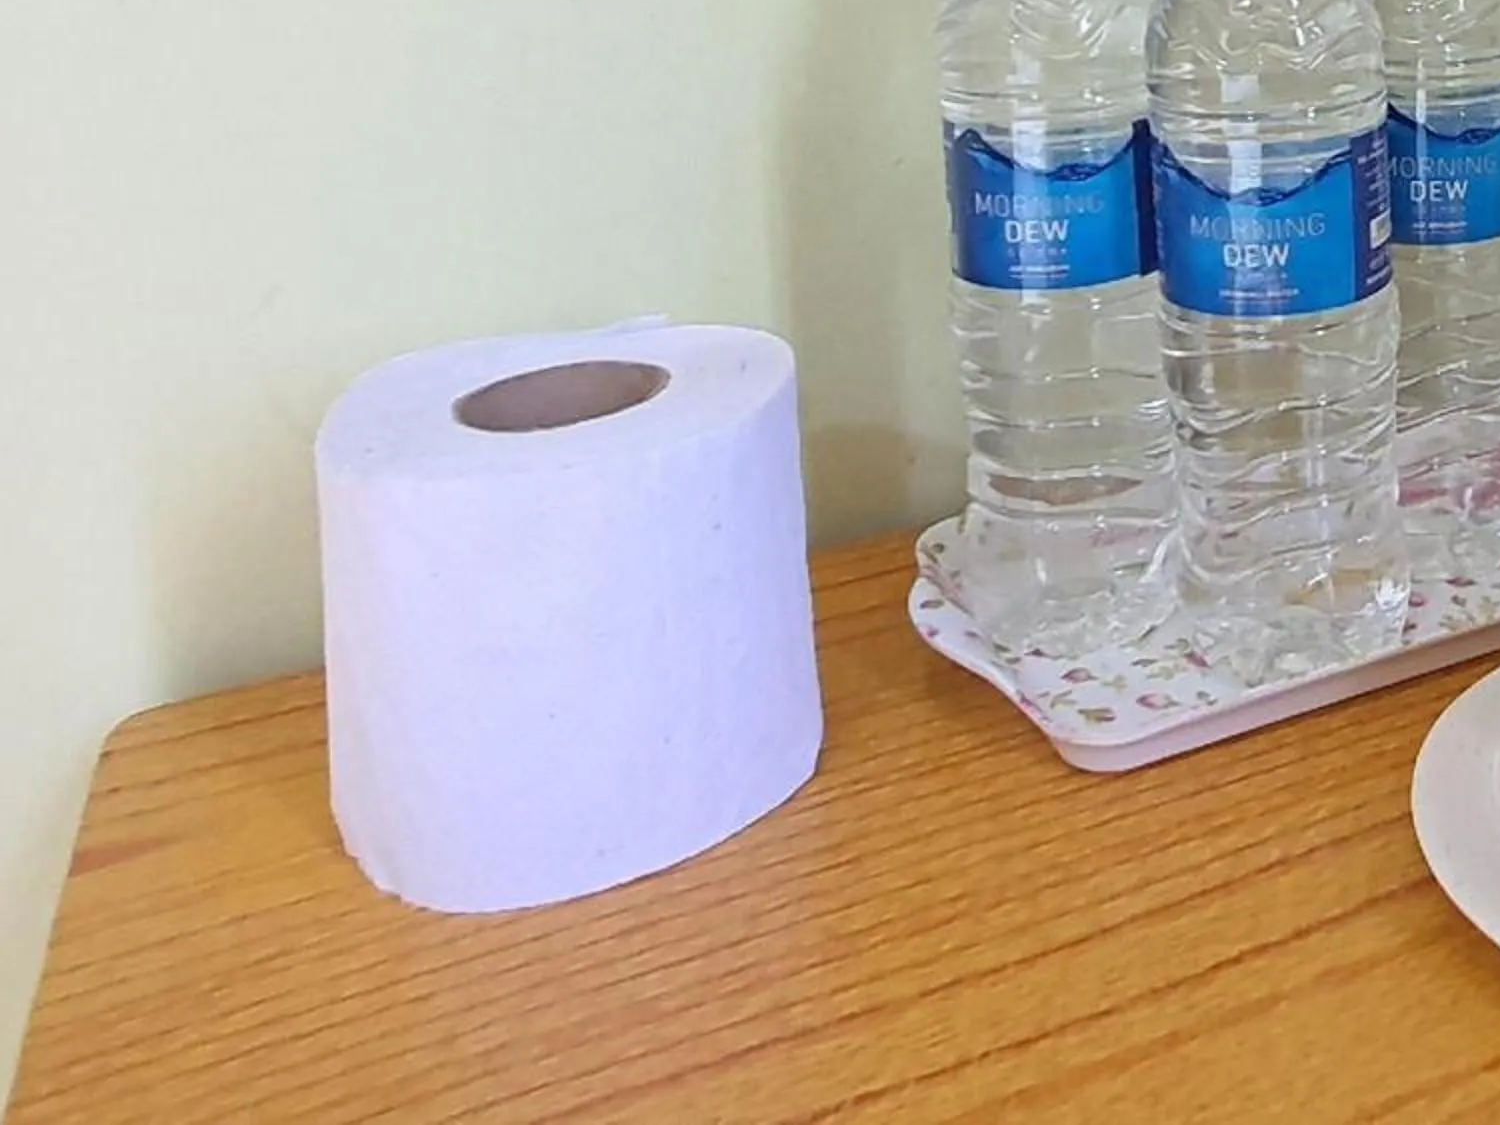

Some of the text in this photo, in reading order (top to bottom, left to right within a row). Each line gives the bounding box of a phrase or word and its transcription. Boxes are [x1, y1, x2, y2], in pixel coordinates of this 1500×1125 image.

[1410, 180, 1469, 203] DEW
[1004, 219, 1070, 244] DEW
[1189, 212, 1327, 240] MORNING
[1222, 242, 1290, 269] DEW
